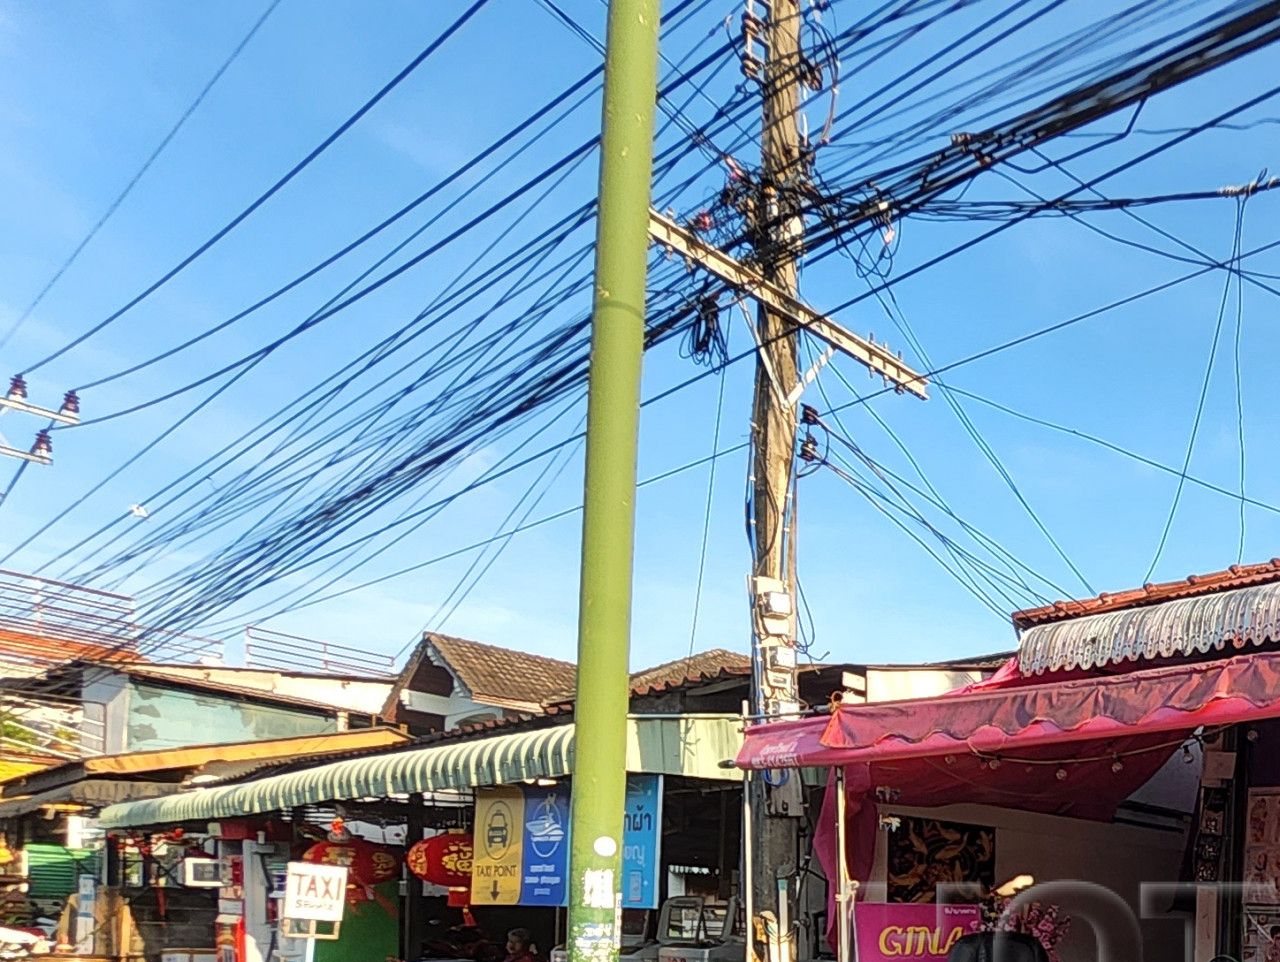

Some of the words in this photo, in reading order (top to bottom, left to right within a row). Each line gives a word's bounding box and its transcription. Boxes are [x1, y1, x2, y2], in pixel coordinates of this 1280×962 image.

[476, 865, 493, 877] TAXI
[494, 864, 517, 877] POINT
[291, 873, 342, 901] TAXI
[879, 926, 964, 956] GINA
